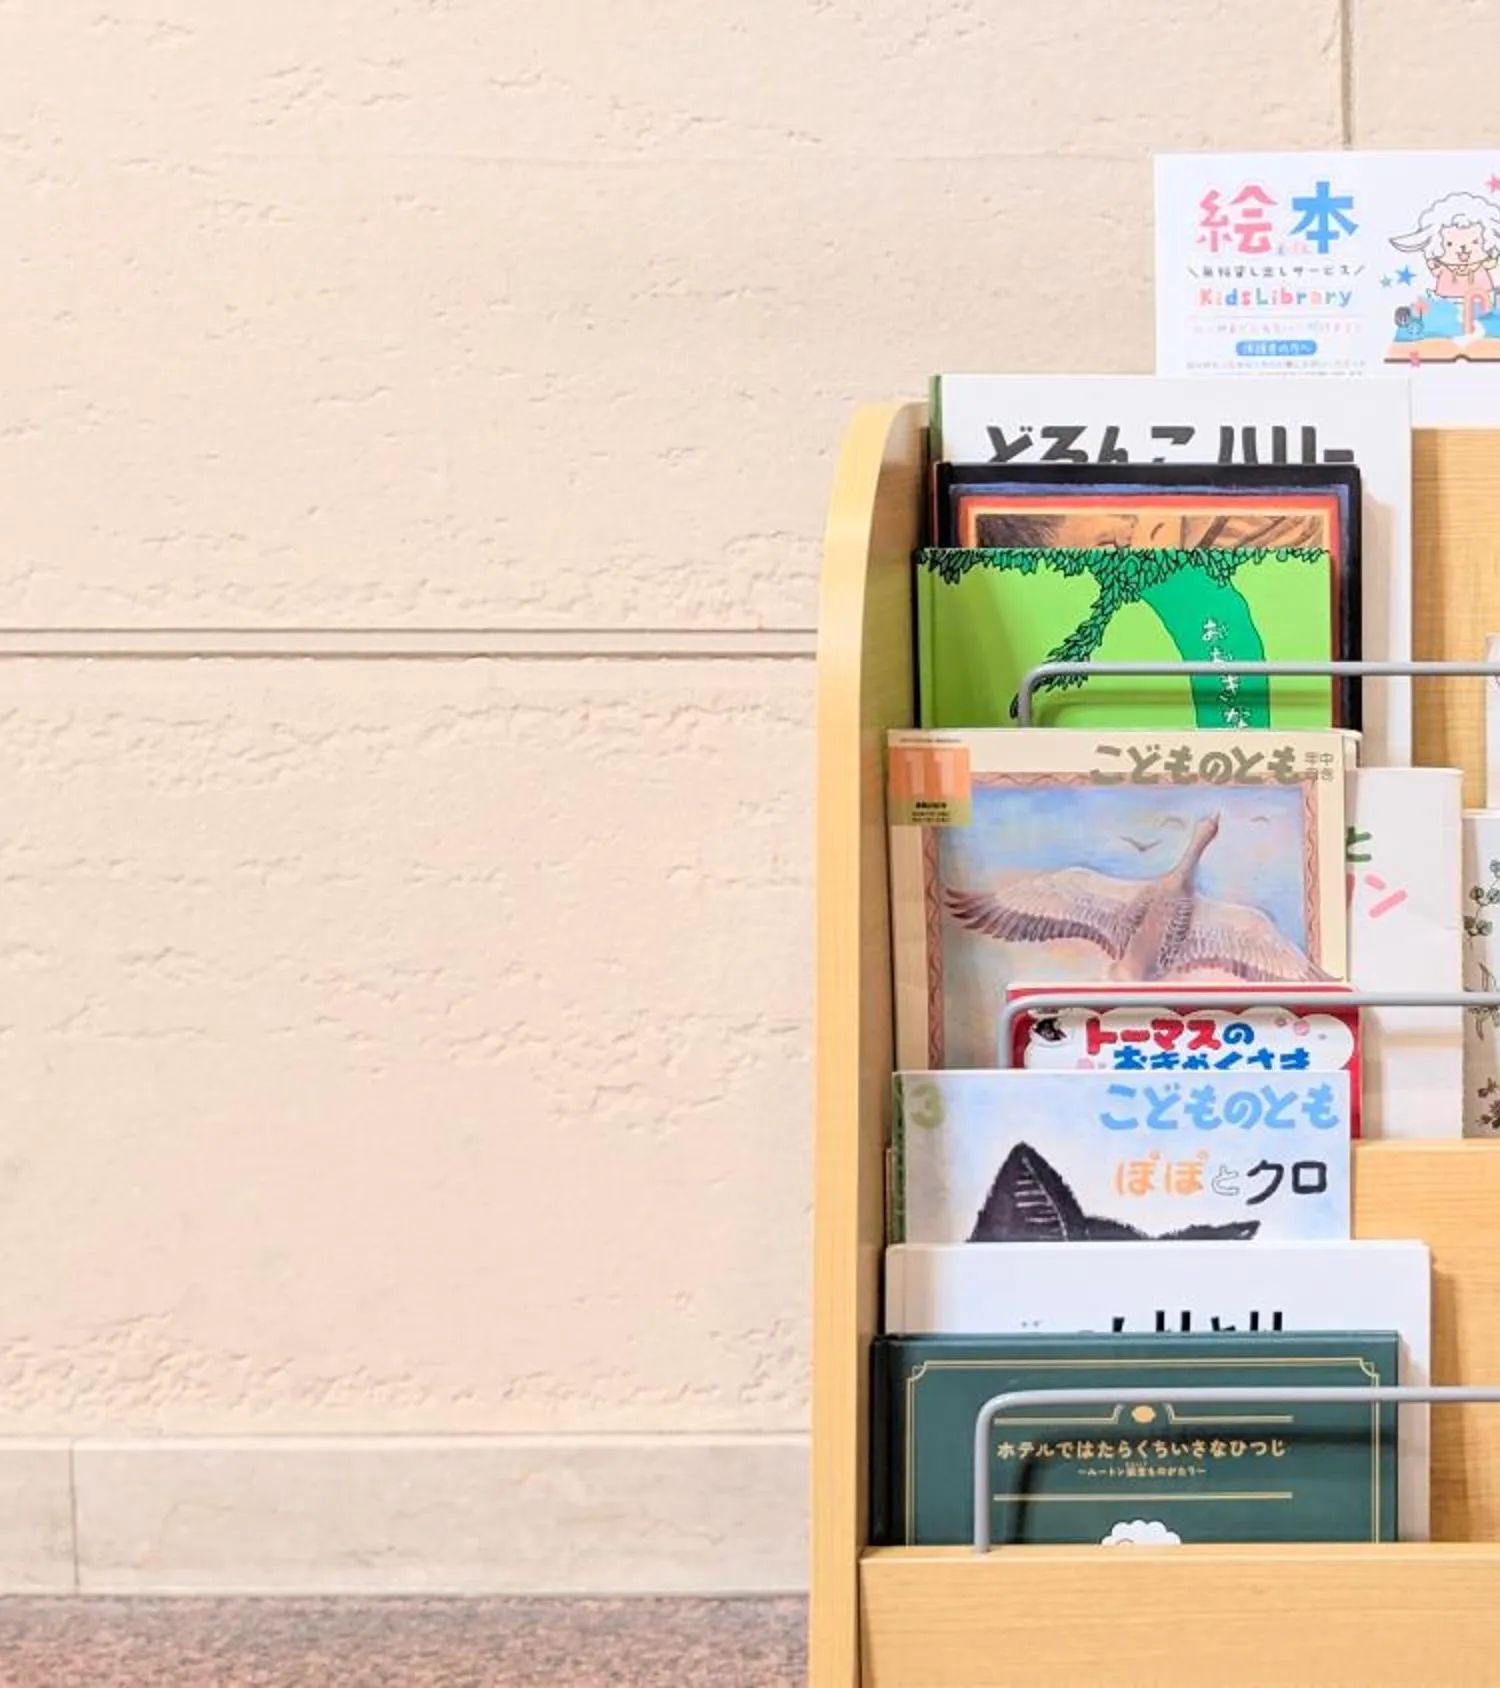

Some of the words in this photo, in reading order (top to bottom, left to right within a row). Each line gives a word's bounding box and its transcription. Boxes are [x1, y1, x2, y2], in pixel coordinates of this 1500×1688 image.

[1196, 181, 1359, 254] 絵本
[1090, 745, 1304, 785] こどものとも
[1086, 1017, 1255, 1056] トーマスの
[1099, 1083, 1341, 1132] こどものとも
[1115, 1150, 1329, 1206] ぽぽとクロ
[996, 1438, 1287, 1460] ホテルではたらくちいさなひつじ
